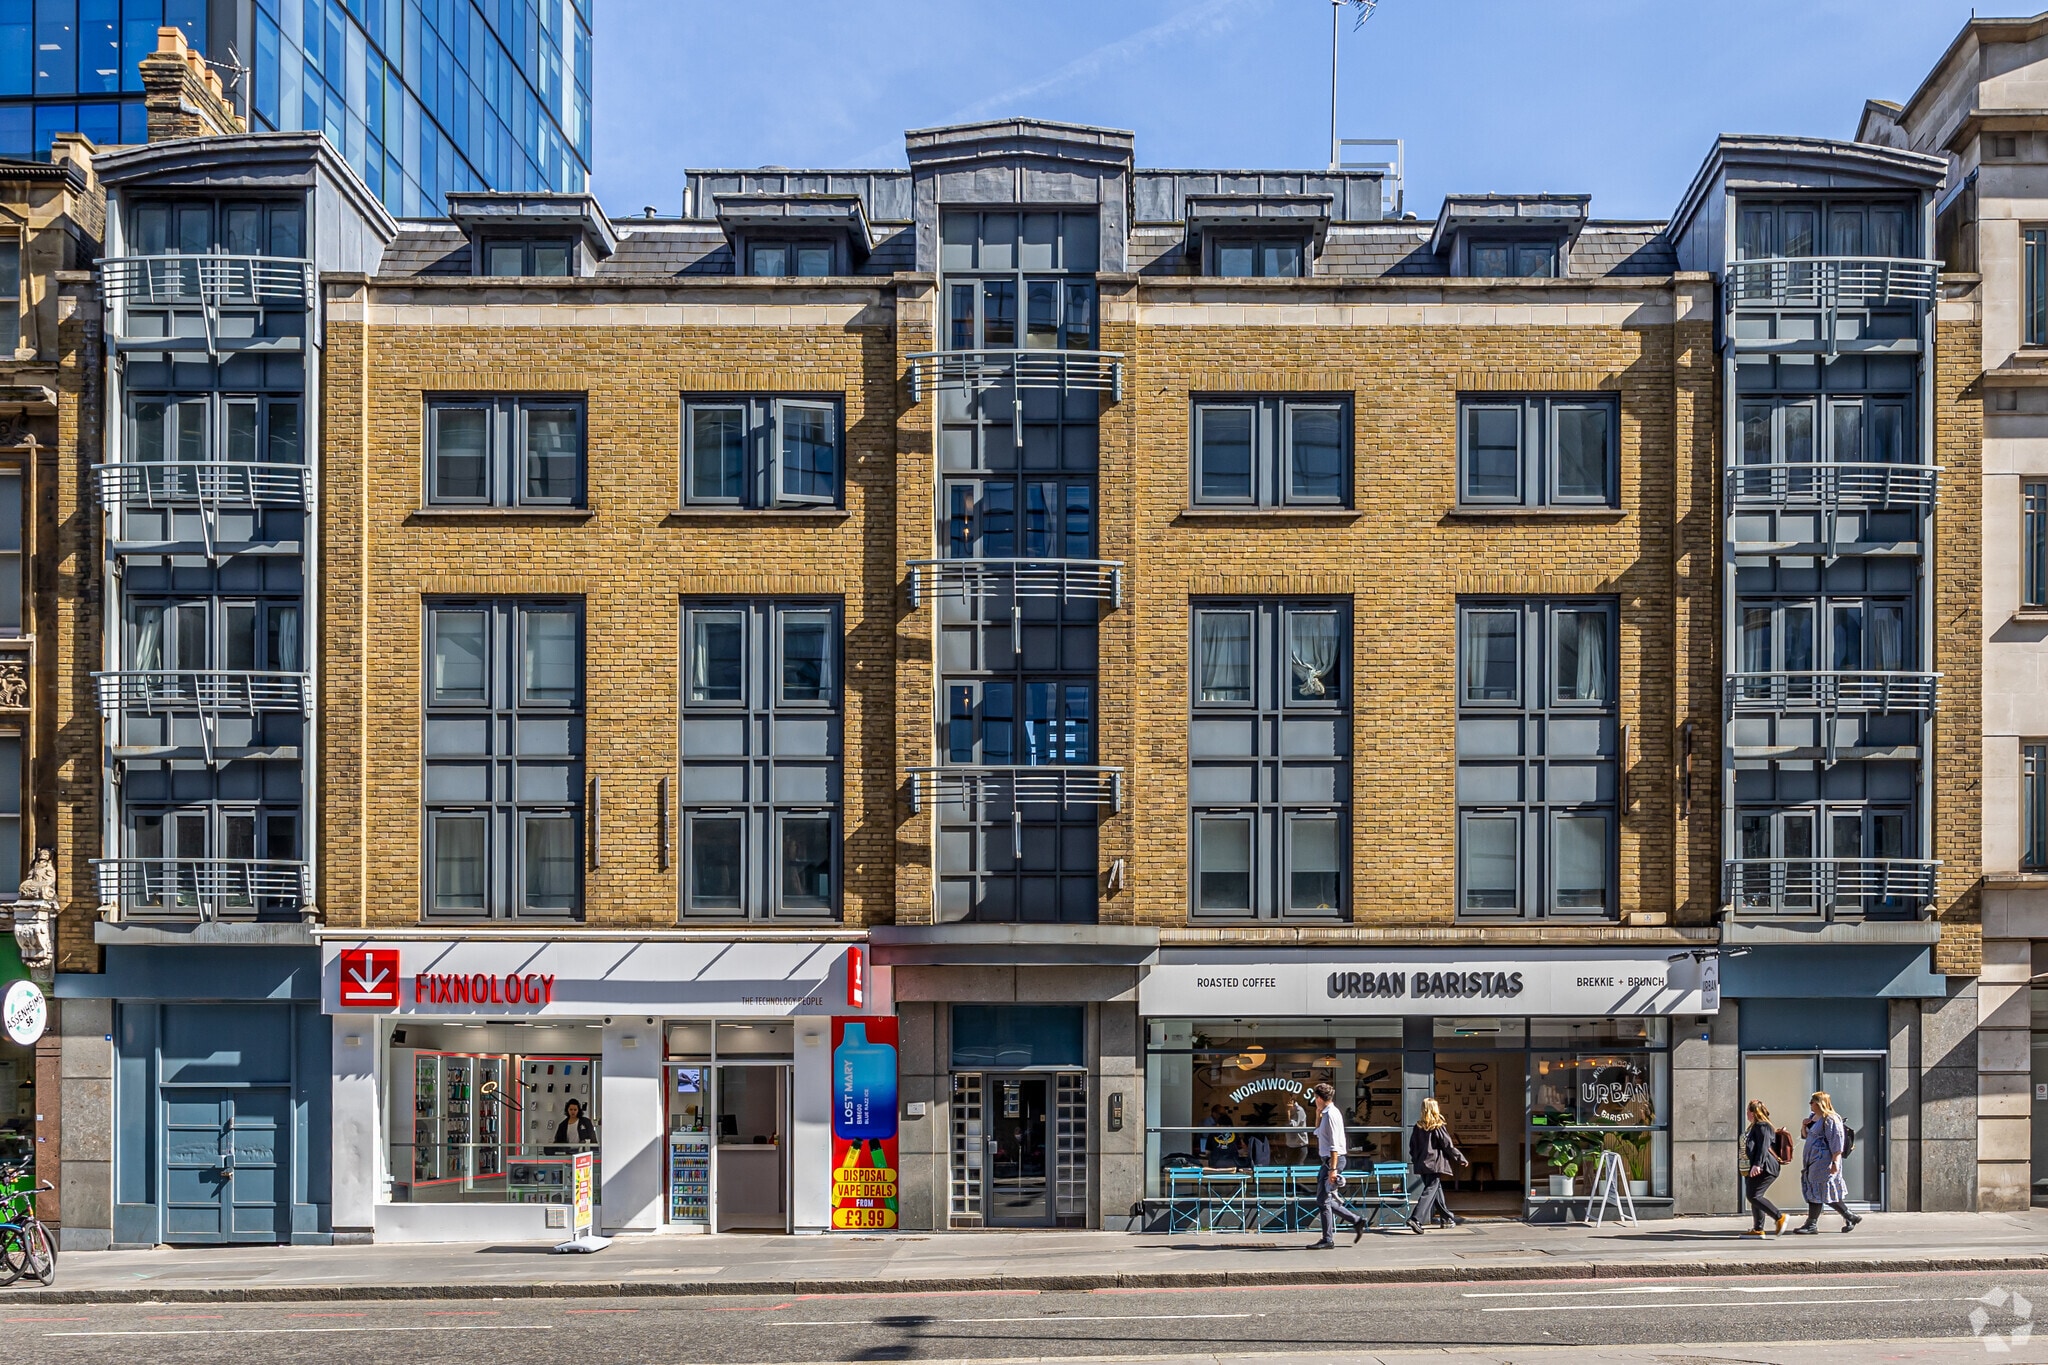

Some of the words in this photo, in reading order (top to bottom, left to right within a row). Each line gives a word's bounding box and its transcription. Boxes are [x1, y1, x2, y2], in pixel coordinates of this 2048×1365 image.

[415, 973, 555, 1004] FIXNOLOGY
[1197, 977, 1239, 988] ROASTED
[1242, 977, 1276, 988] COFFEE
[1327, 972, 1406, 998] URBAN
[1411, 972, 1524, 998] BARISTAS
[1576, 977, 1614, 987] BREKKIE
[1627, 976, 1665, 987] BRUNCH
[7, 992, 44, 1030] ASSENHEIMS
[742, 996, 753, 1006] THE
[755, 996, 798, 1006] TECHNOLOGY
[798, 996, 823, 1006] PEOPLE
[844, 1060, 853, 1092] MARY
[1229, 1077, 1303, 1103] WORMWOOD
[1582, 1082, 1650, 1104] URBAN
[844, 1094, 853, 1125] LOST
[843, 1169, 888, 1181] DISPOSAL
[837, 1184, 861, 1196] VAPE
[863, 1184, 893, 1197] DEALS
[855, 1198, 874, 1207] FROM
[844, 1209, 885, 1227] £3.99
